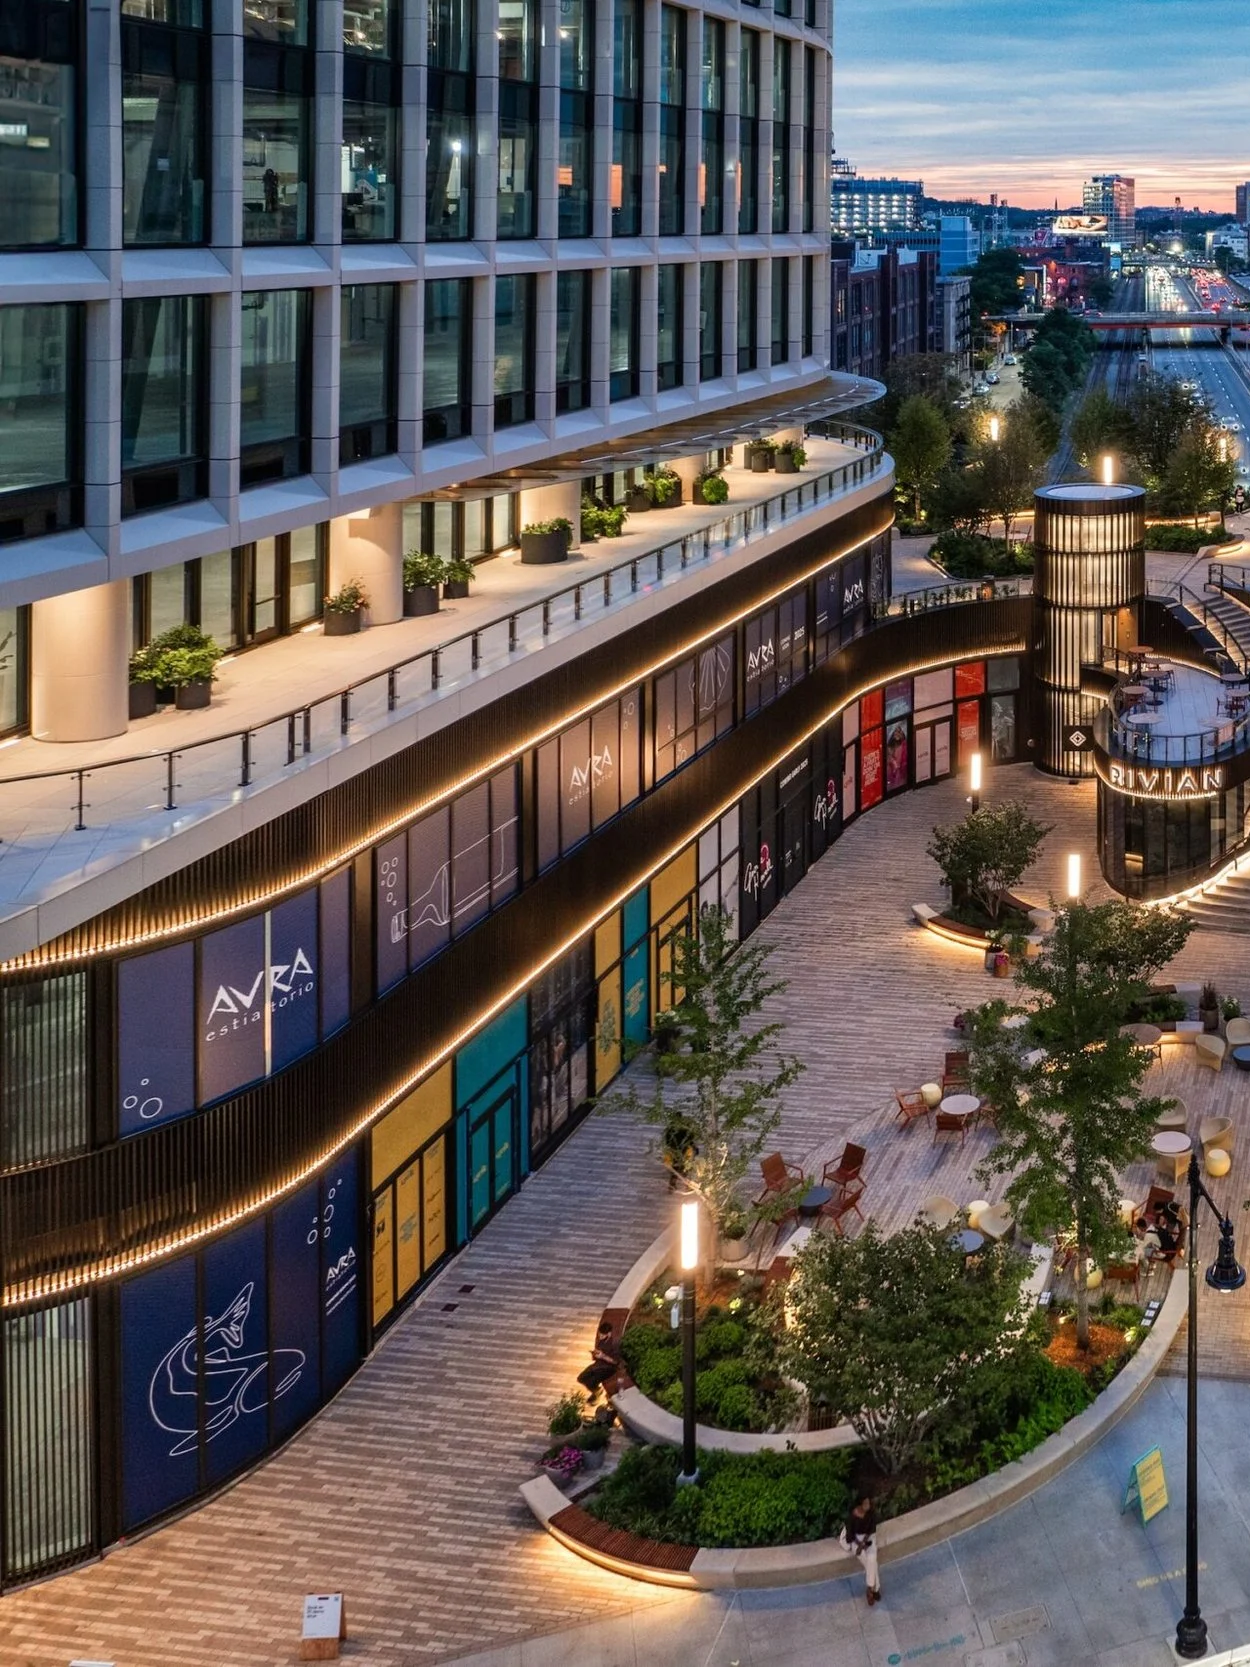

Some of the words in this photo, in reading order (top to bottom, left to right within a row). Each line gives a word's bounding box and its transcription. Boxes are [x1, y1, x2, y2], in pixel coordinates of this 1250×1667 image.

[747, 638, 775, 672] AVRA
[568, 745, 613, 793] AVRA
[1110, 766, 1223, 793] RIVIAN
[206, 947, 314, 1025] AVRA
[205, 981, 314, 1042] estiatorio
[326, 1246, 357, 1283] AVRA
